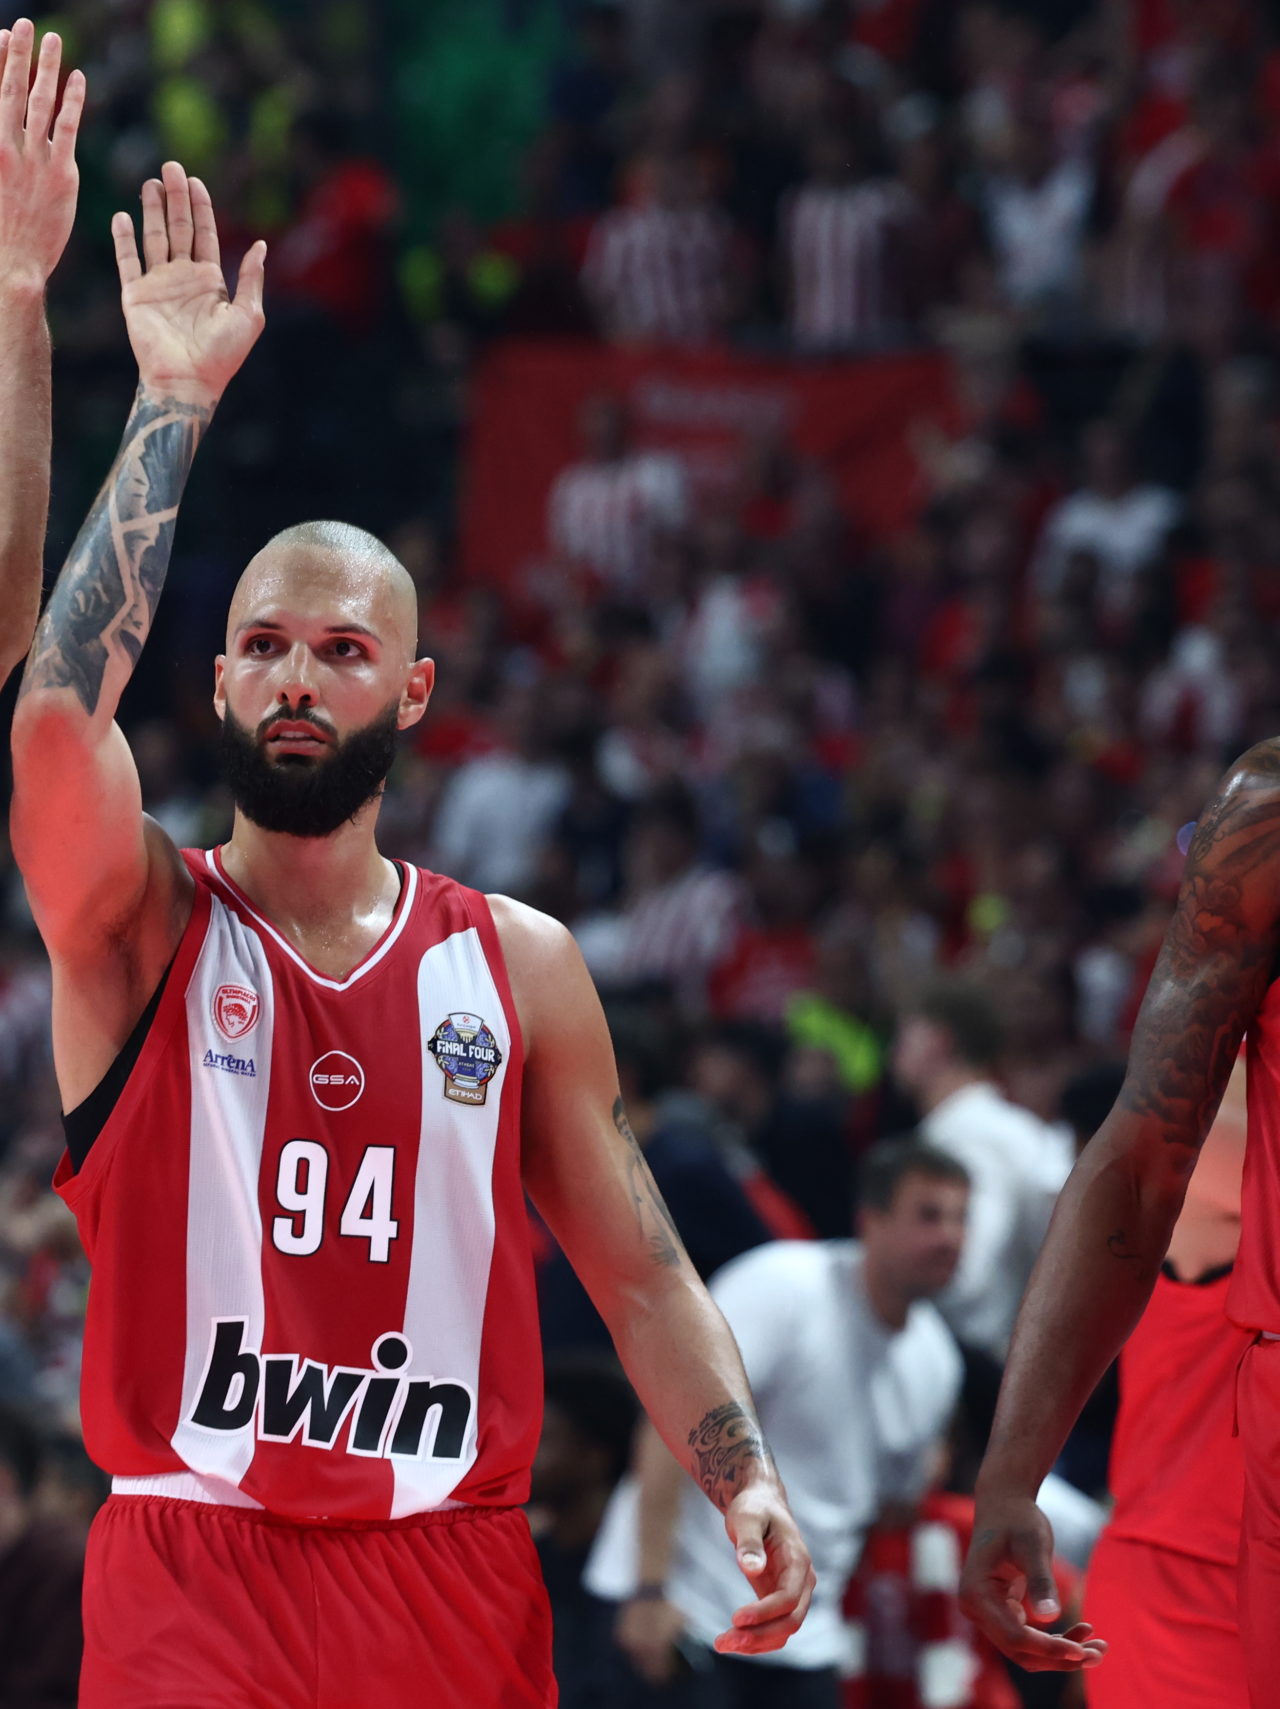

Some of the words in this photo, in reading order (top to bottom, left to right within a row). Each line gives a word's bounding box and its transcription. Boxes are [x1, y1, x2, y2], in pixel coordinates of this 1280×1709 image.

[436, 1040, 467, 1056] FINAL
[468, 1045, 495, 1062] FOUR
[312, 1074, 360, 1085] GSA
[448, 1088, 482, 1100] ETIHAD
[271, 1137, 400, 1263] 94
[186, 1317, 476, 1462] bwin
